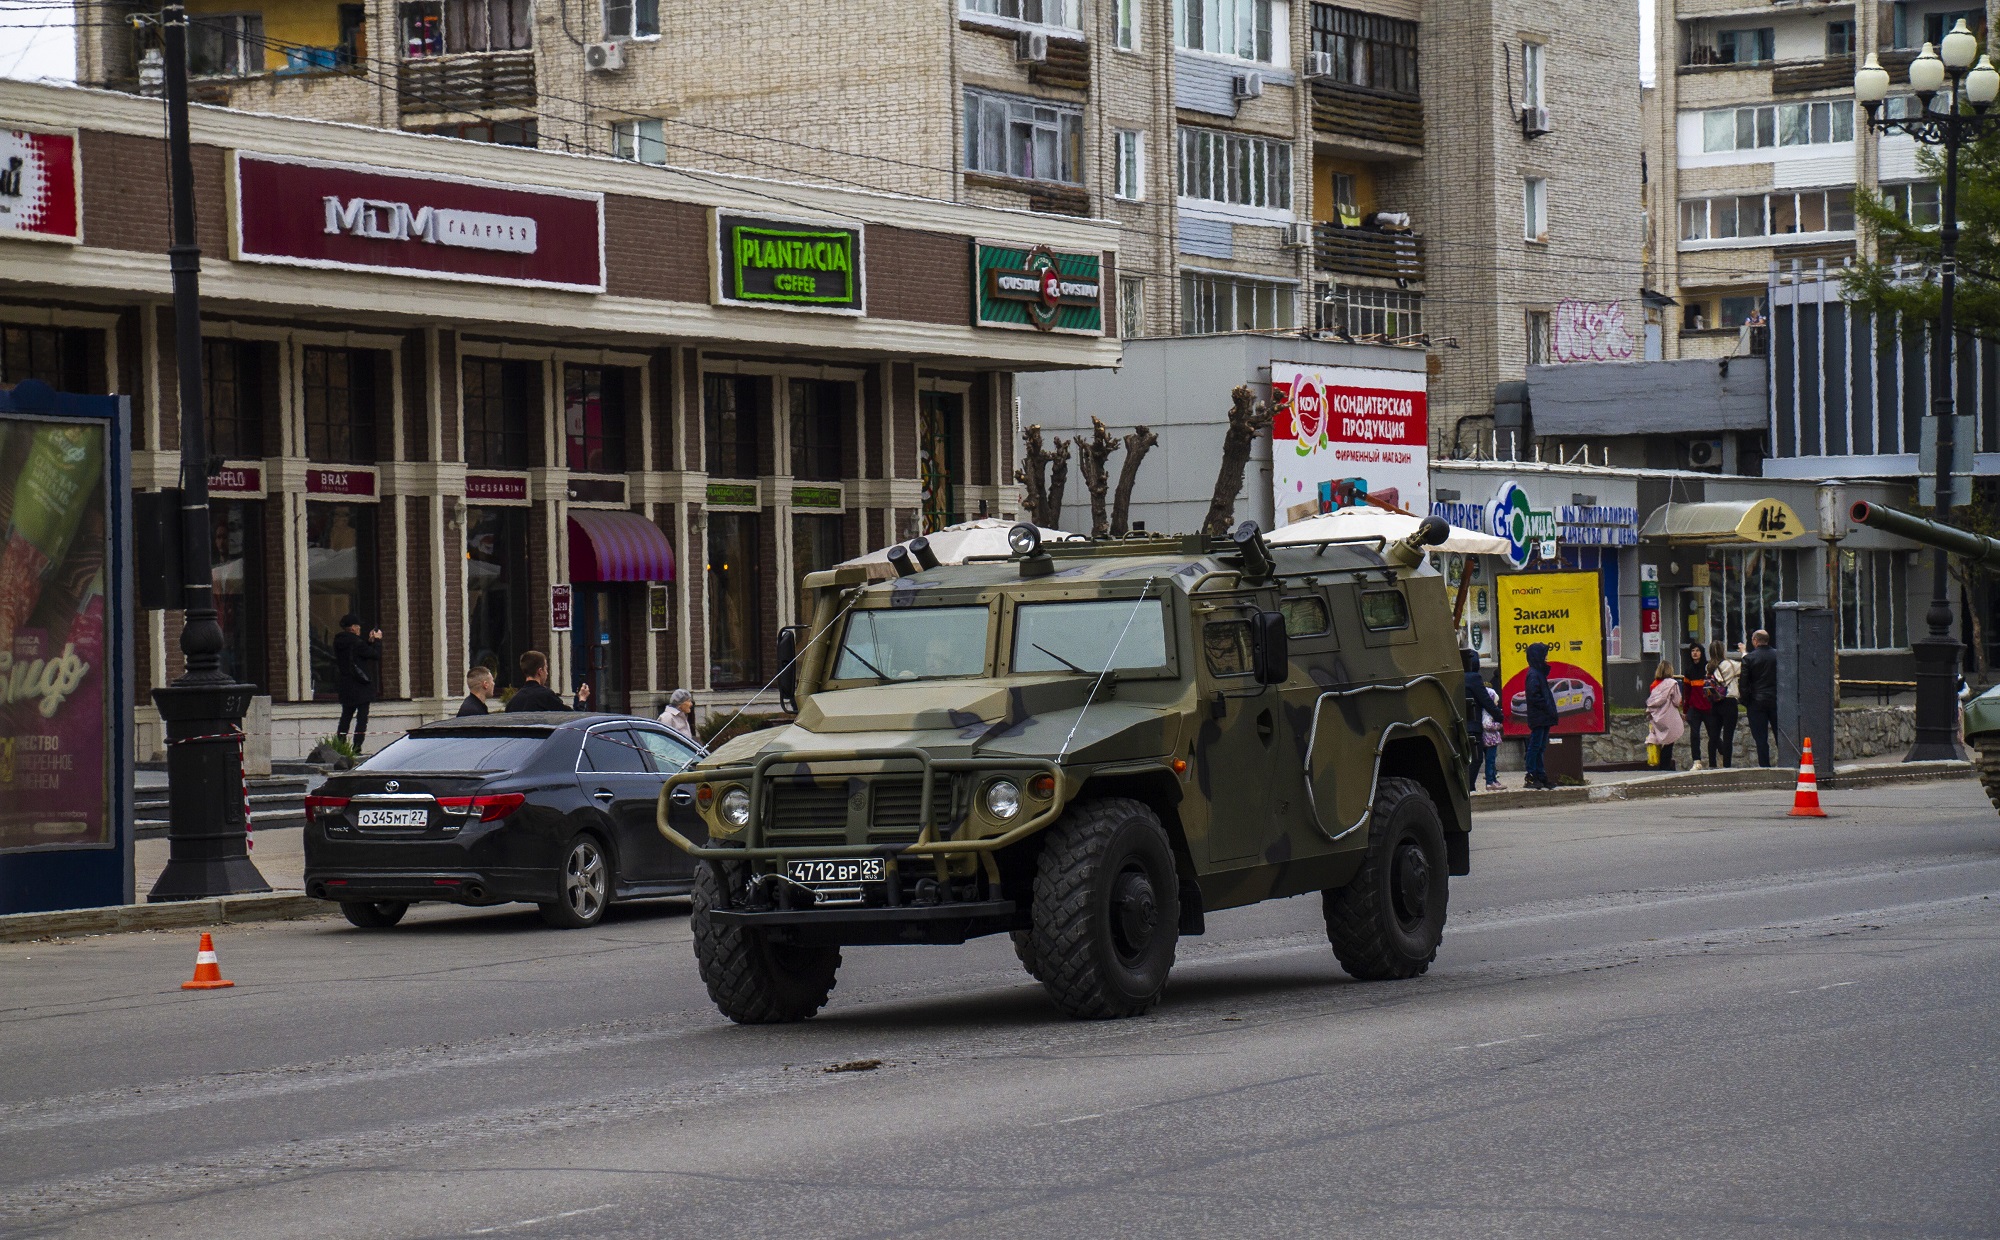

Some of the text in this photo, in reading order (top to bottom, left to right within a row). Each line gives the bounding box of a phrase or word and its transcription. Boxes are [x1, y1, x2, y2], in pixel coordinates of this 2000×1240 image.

[449, 219, 527, 240] ГАЛЕРЕЯ
[742, 238, 848, 272] PLANTACIA
[774, 273, 816, 293] COFFEE
[1047, 279, 1060, 297] &
[1299, 396, 1318, 412] KDV
[1333, 394, 1412, 417] КОНДИТЕРСКАЯ
[1342, 418, 1405, 441] ПРОДУКЦИЯ
[1335, 449, 1411, 464] ФИРМЕННЫЙ МАГАЗИН
[321, 473, 348, 485] BRAX
[1429, 502, 1484, 530] ОМАРКЕТ
[1512, 587, 1541, 595] maxim
[1513, 608, 1569, 620] Закажи
[1514, 624, 1555, 634] такси
[411, 811, 424, 821] 27
[862, 861, 879, 874] 25
